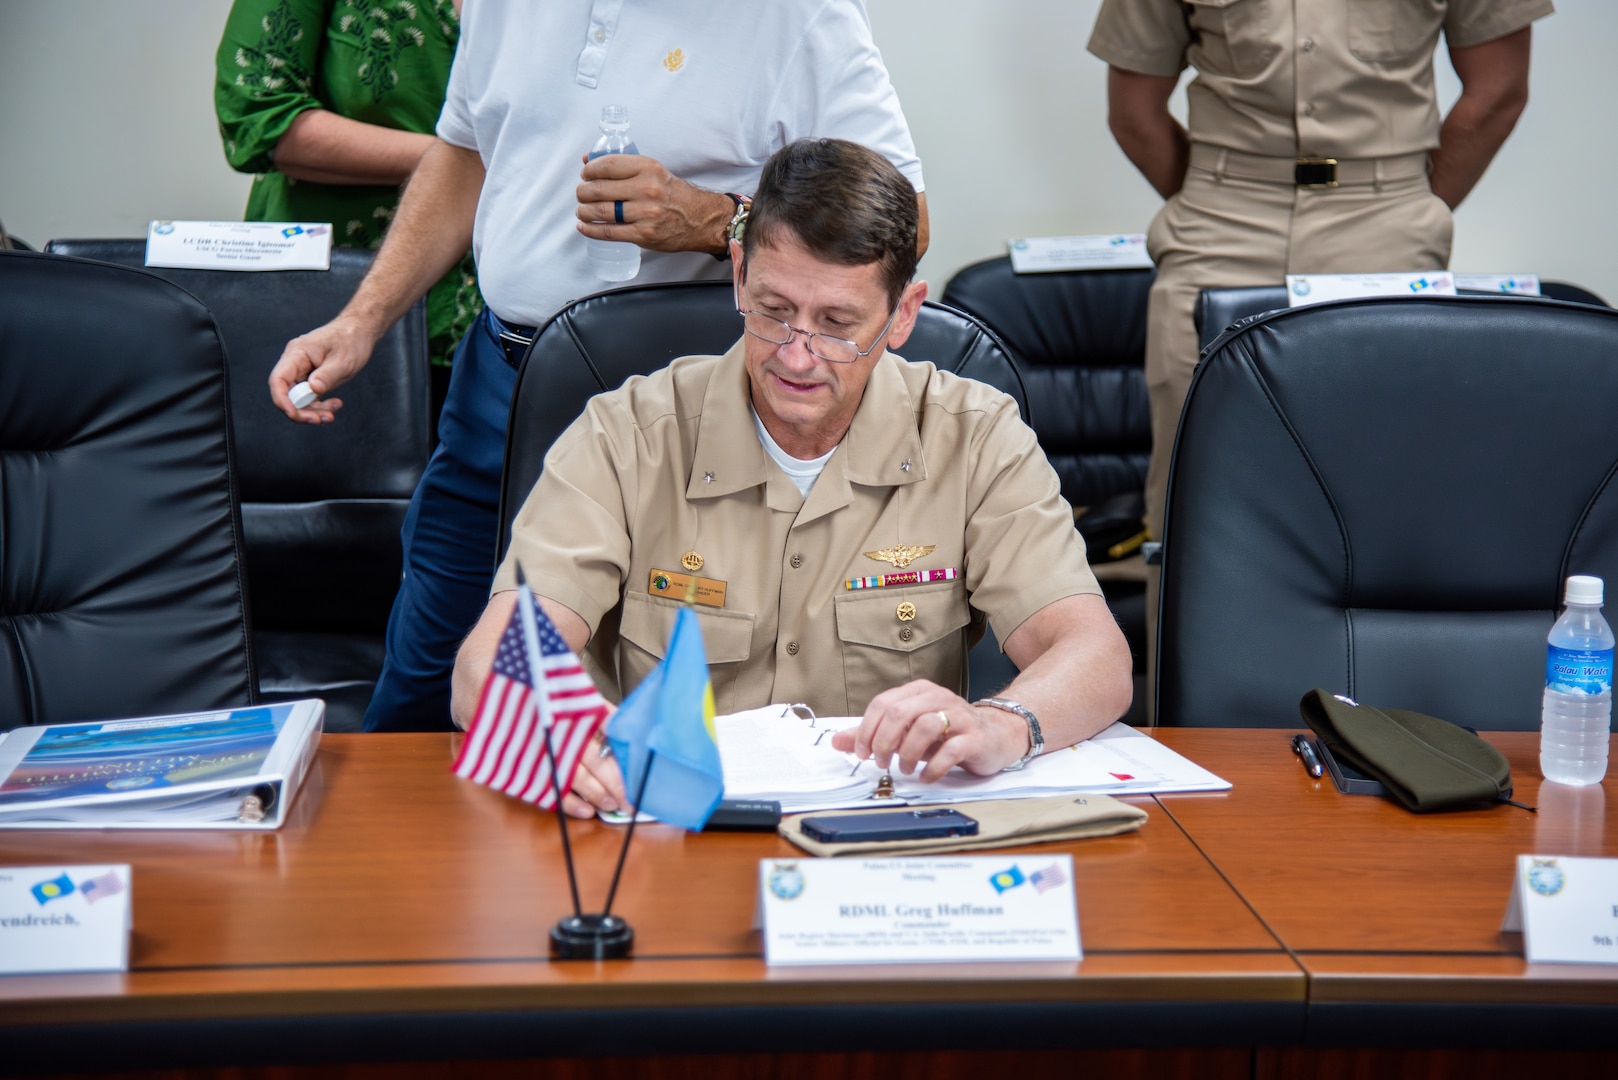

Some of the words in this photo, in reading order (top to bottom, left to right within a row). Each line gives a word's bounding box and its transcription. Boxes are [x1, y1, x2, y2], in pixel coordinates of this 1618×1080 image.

[1554, 663, 1578, 675] Palau
[839, 904, 891, 917] RDML
[895, 904, 932, 918] Greg
[938, 903, 1004, 916] Huffman
[1593, 935, 1613, 946] 9th
